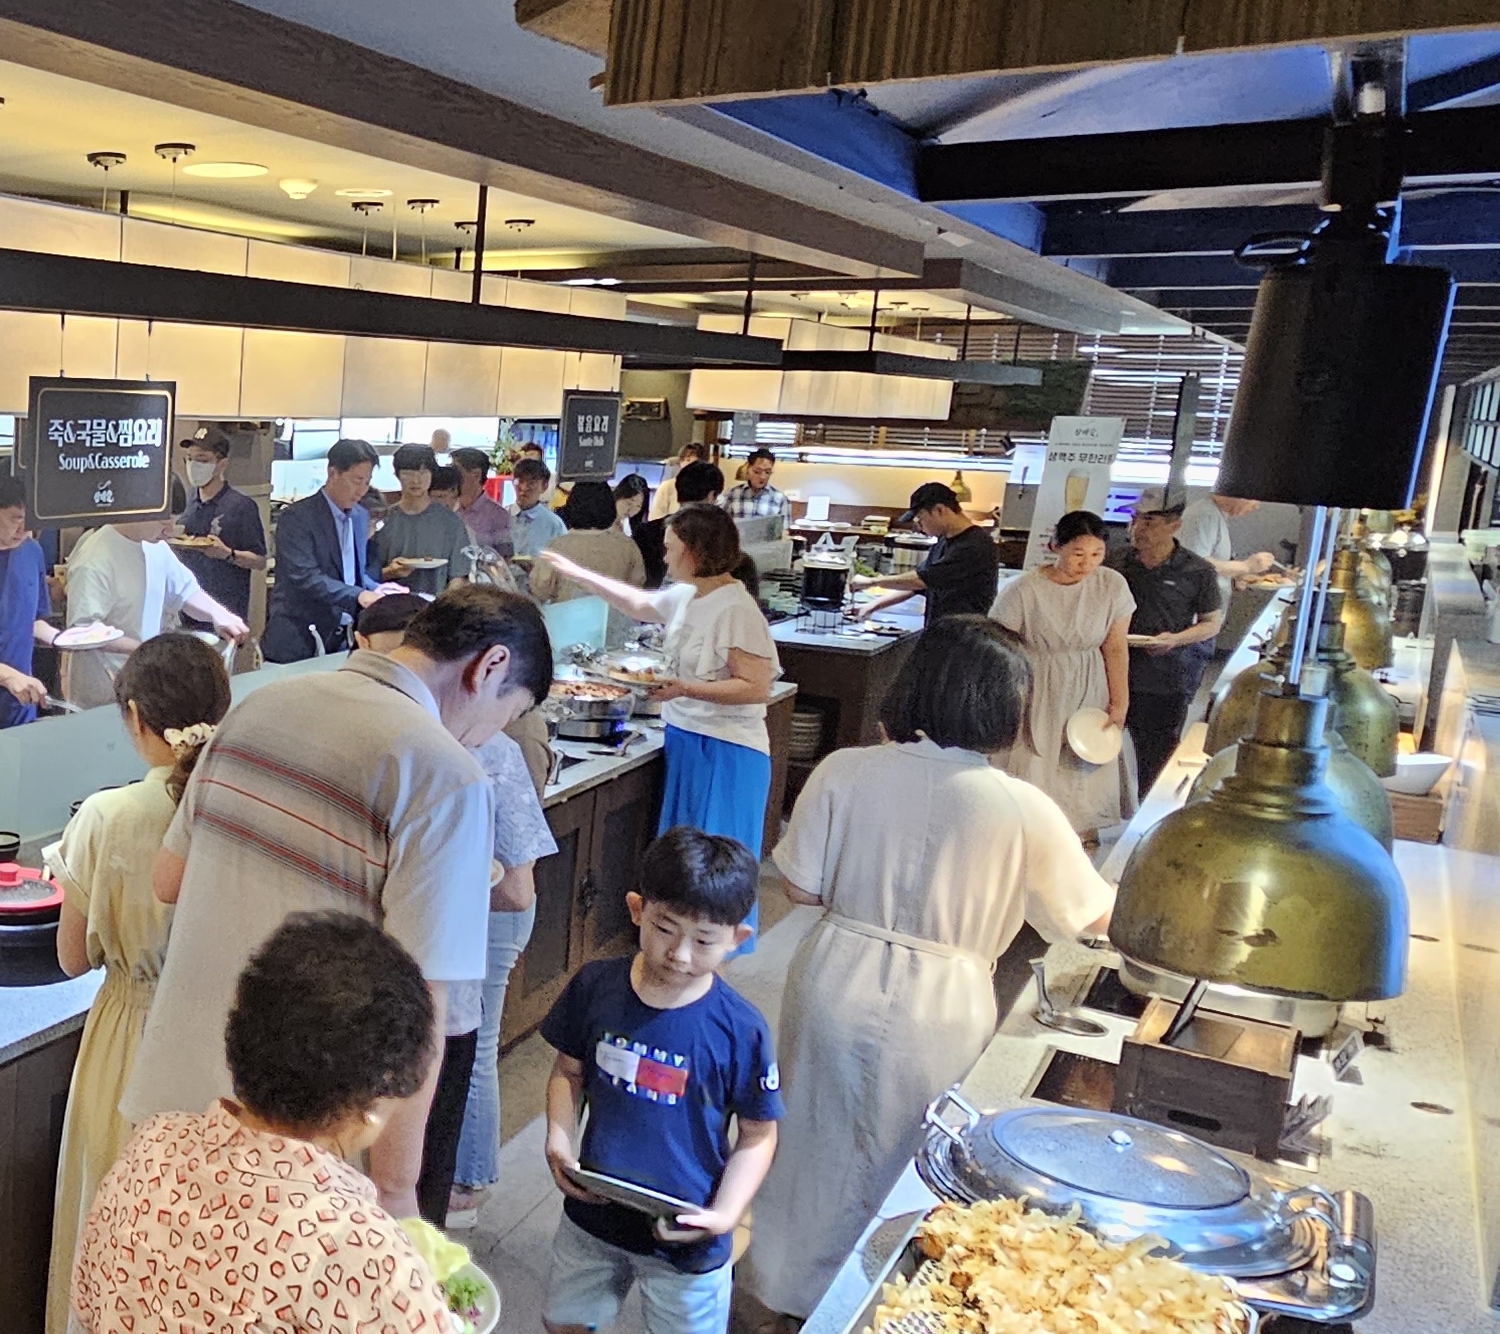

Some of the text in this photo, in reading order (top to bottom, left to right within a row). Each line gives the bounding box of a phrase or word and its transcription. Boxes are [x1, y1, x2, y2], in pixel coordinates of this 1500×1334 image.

[47, 418, 163, 448] 죽&국물&찜요리
[577, 414, 610, 434] 볶음요리
[58, 450, 150, 474] Soup&Casserole
[1048, 451, 1077, 463] 생맥주
[603, 1030, 685, 1067] TOMMY
